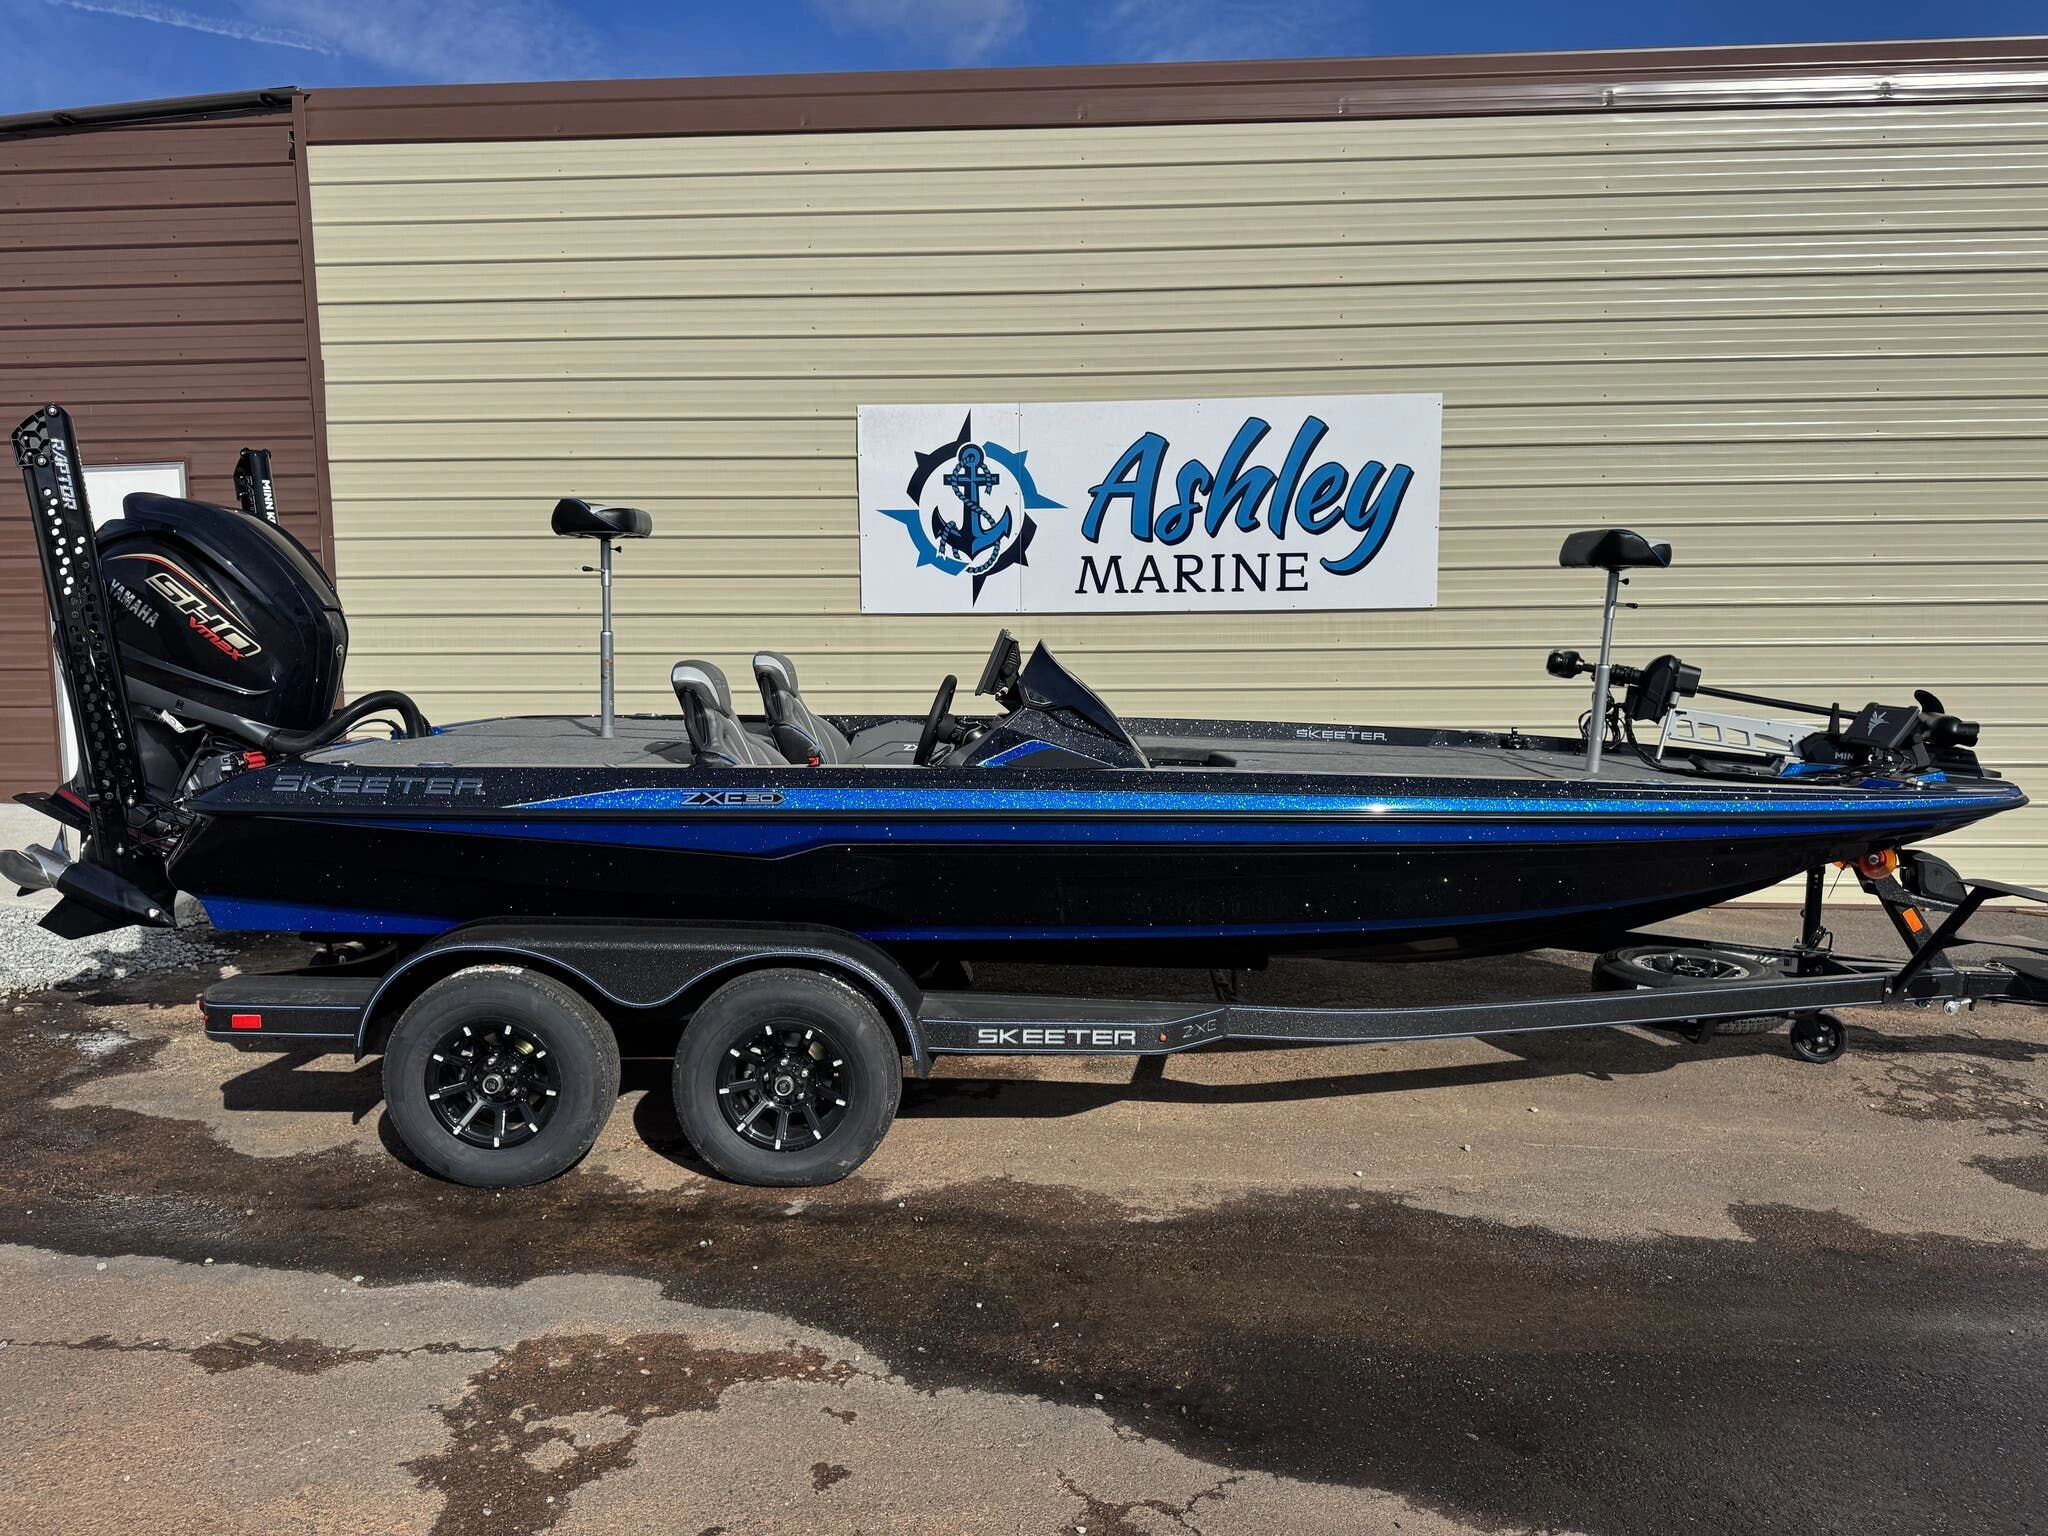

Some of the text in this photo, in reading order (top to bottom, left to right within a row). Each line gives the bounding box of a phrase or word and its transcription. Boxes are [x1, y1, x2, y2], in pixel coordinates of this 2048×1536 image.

[50, 438, 78, 510] RAPTOR
[261, 479, 275, 510] MINN
[1081, 414, 1415, 577] Ashley
[1074, 552, 1309, 594] MARINE
[109, 578, 160, 629] YAMAHA
[144, 572, 262, 658] SHO
[1295, 728, 1386, 741] SKEETER
[1834, 751, 1855, 761] MIN
[271, 774, 487, 796] SKEETER
[977, 1018, 1218, 1046] SKEETER ZXE
